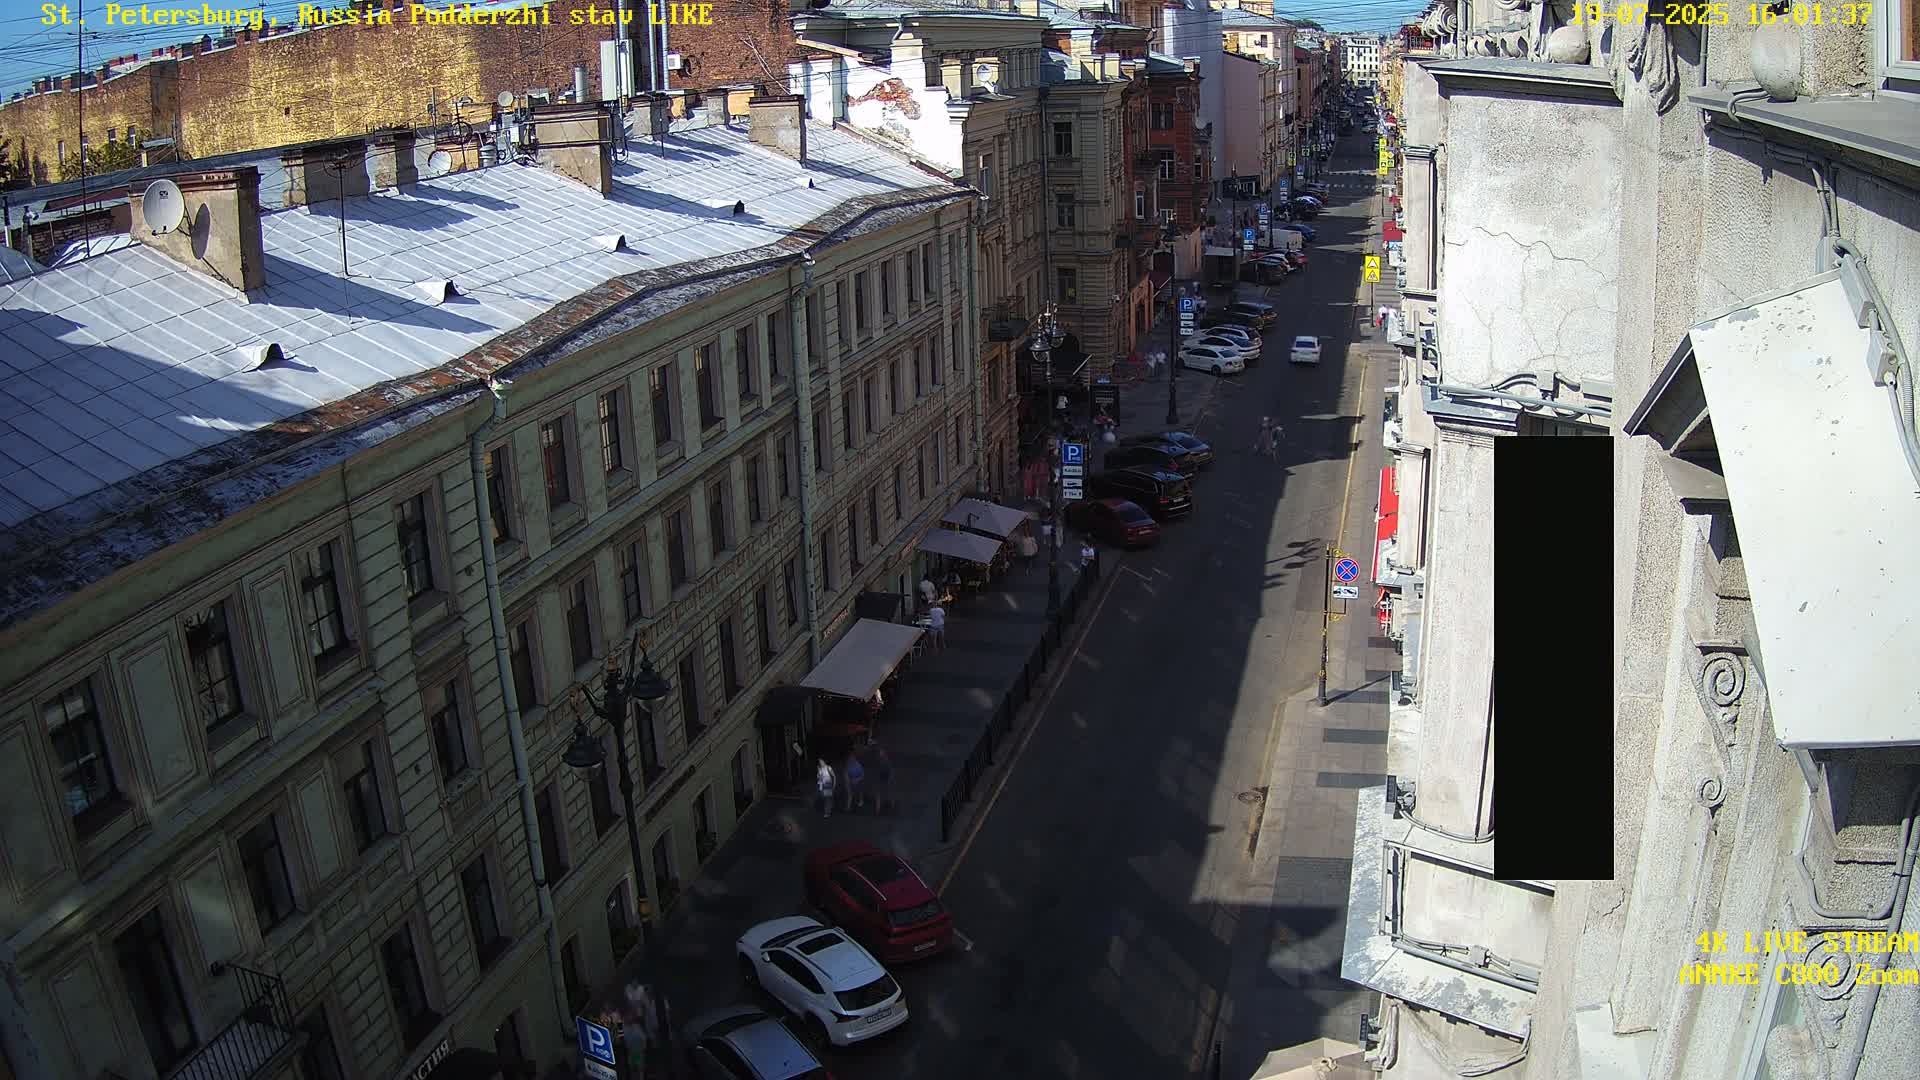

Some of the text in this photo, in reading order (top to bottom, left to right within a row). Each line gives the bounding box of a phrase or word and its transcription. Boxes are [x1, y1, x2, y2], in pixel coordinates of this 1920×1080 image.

[1183, 299, 1192, 310] P
[1068, 445, 1079, 461] P
[586, 1023, 606, 1053] P
